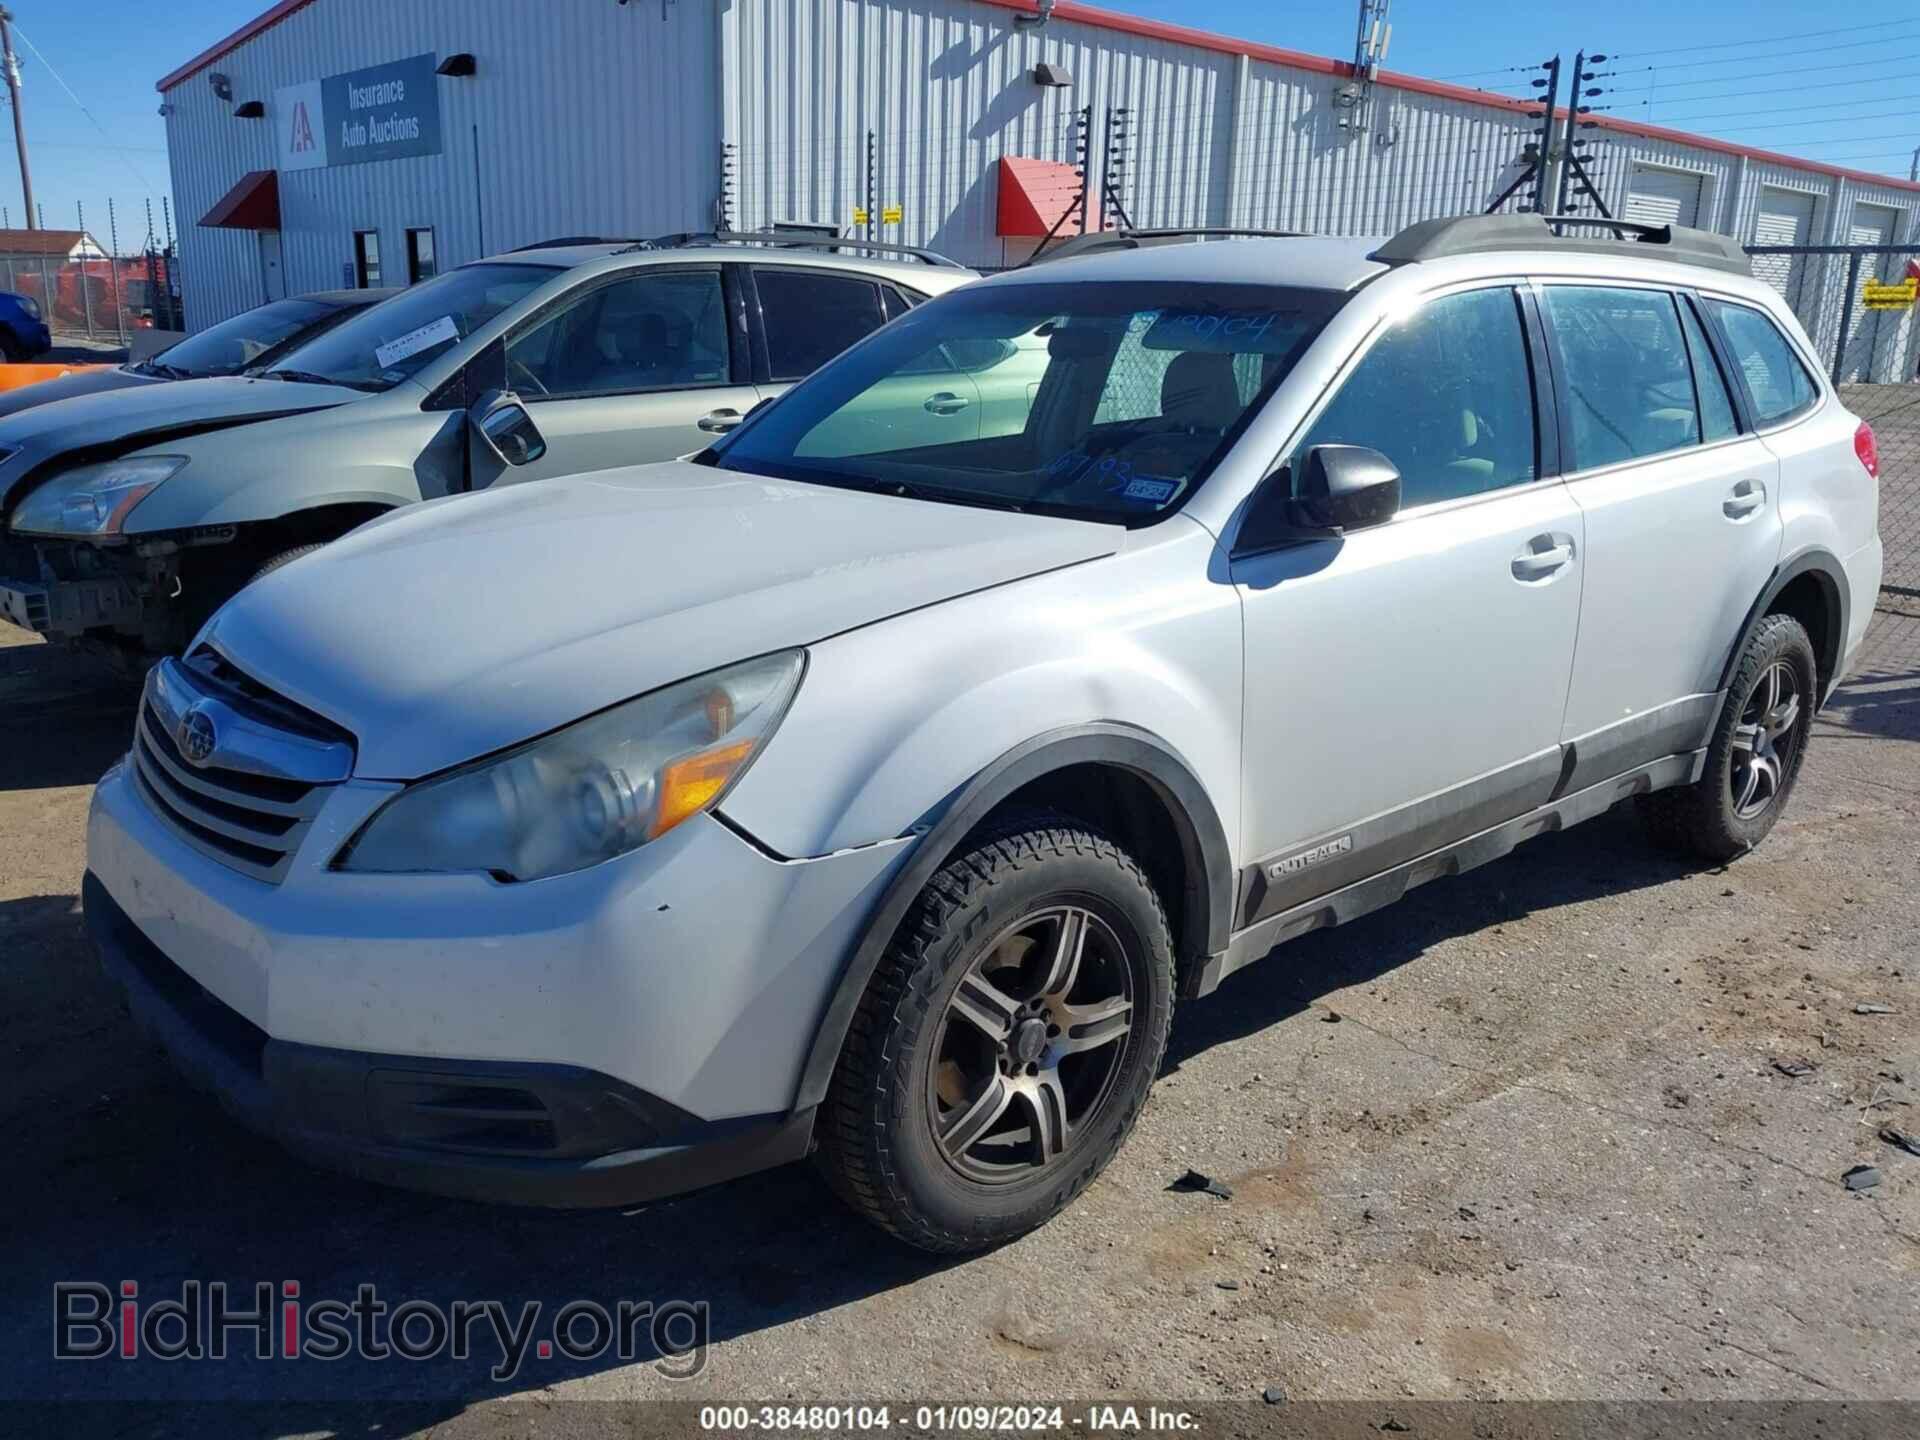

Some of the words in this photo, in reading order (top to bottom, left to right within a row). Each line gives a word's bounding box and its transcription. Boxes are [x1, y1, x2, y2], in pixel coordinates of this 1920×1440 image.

[348, 79, 405, 111] Insurance
[341, 119, 366, 148] Auto
[368, 112, 420, 144] Auctions
[1268, 835, 1351, 879] OUTBACK
